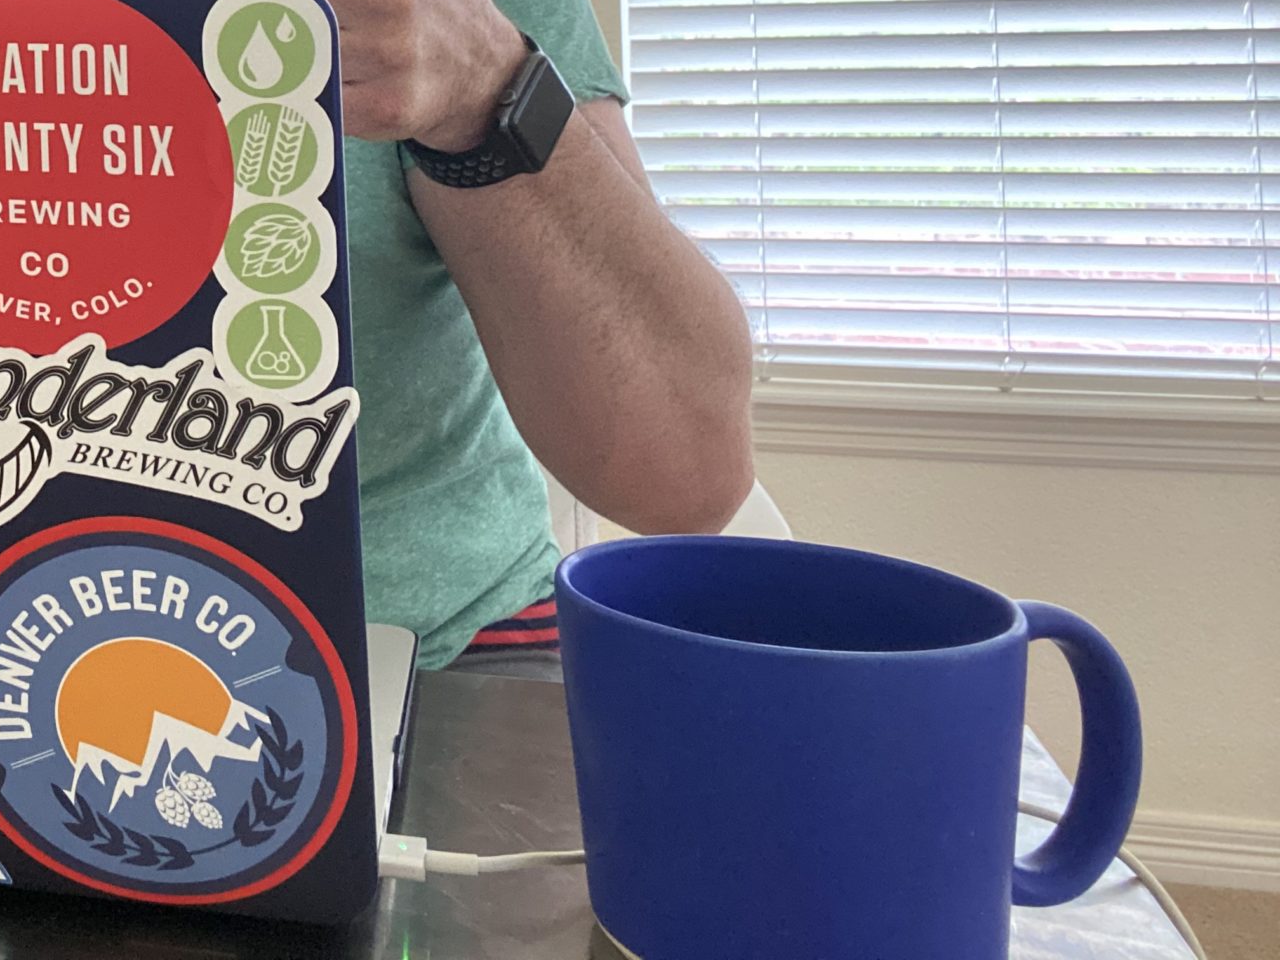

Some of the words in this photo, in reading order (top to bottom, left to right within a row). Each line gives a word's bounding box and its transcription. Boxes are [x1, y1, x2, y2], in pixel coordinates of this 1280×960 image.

[101, 123, 175, 177] SIX
[20, 250, 70, 278] CO
[70, 276, 154, 321] COLO.
[66, 441, 235, 496] BREWING
[241, 480, 295, 522] CO.
[68, 568, 190, 621] BEER
[194, 593, 256, 657] CO.
